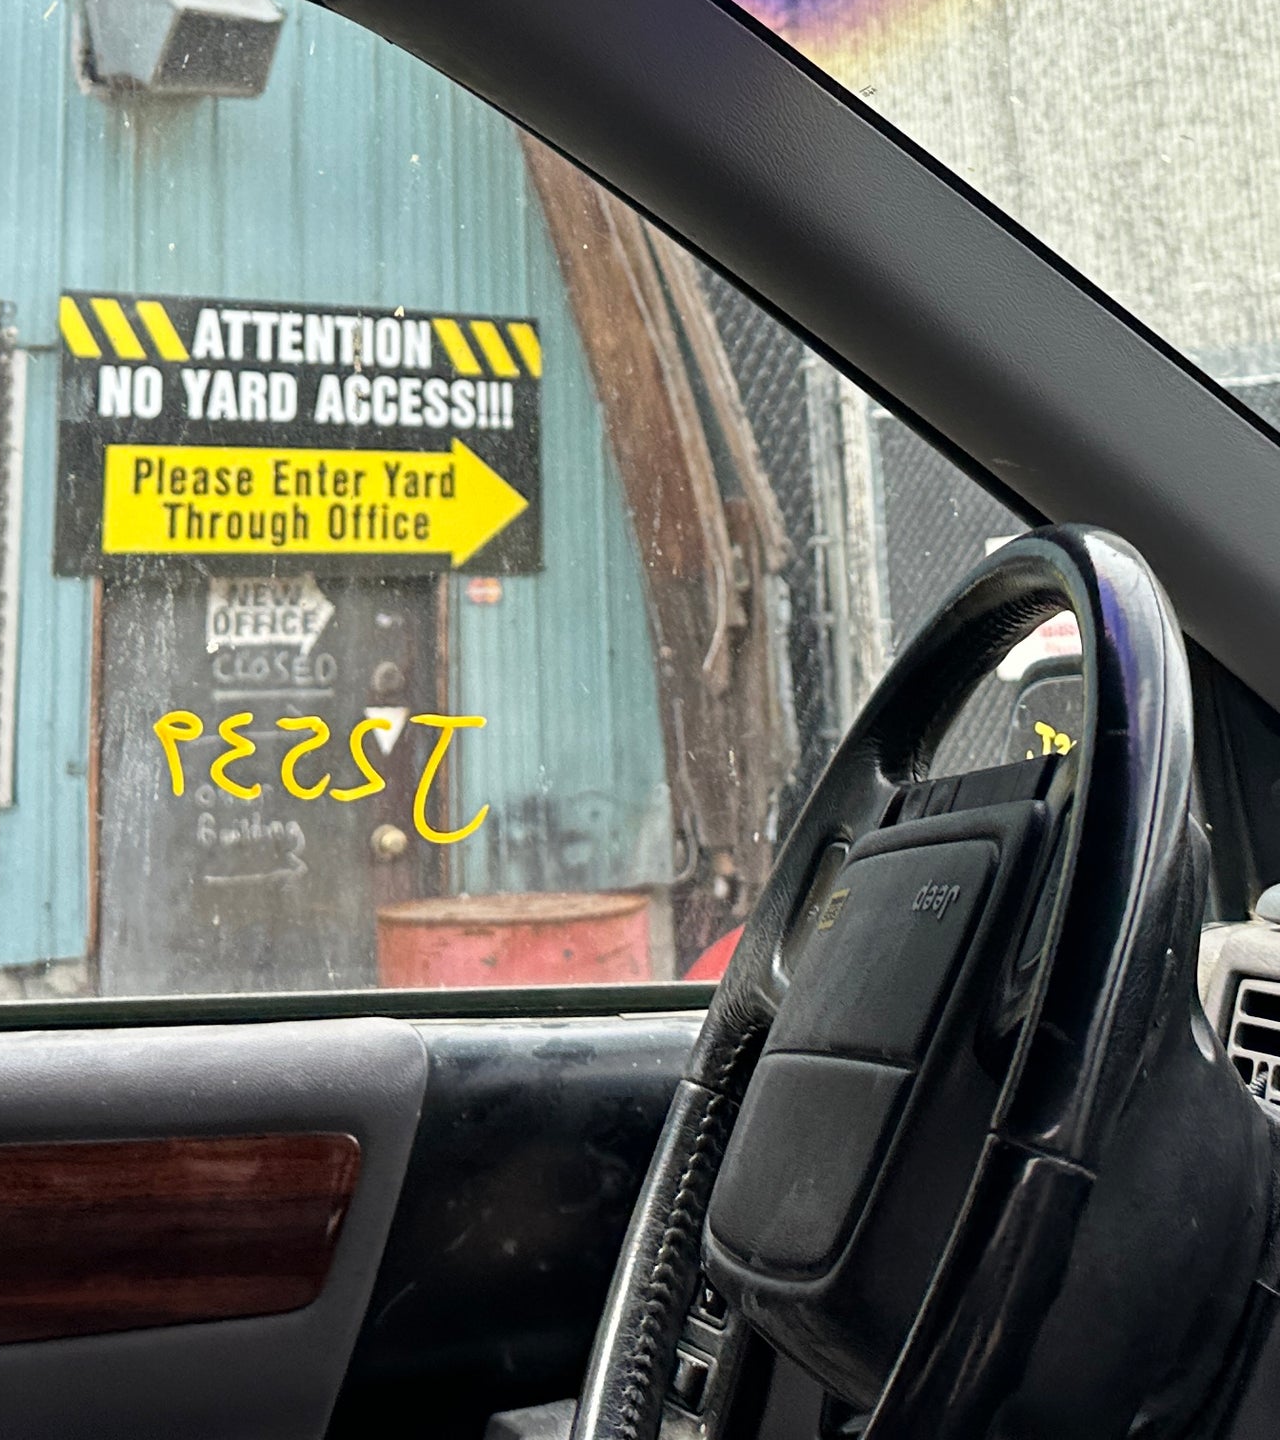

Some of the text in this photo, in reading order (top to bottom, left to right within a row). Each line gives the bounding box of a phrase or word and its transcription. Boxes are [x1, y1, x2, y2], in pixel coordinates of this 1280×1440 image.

[191, 307, 433, 371] ATTENTION
[98, 364, 514, 429] NO YARD ACCESS!!!
[133, 456, 456, 500] Please Enter Yard
[164, 502, 430, 547] Through Office
[212, 607, 318, 636] OFFICE
